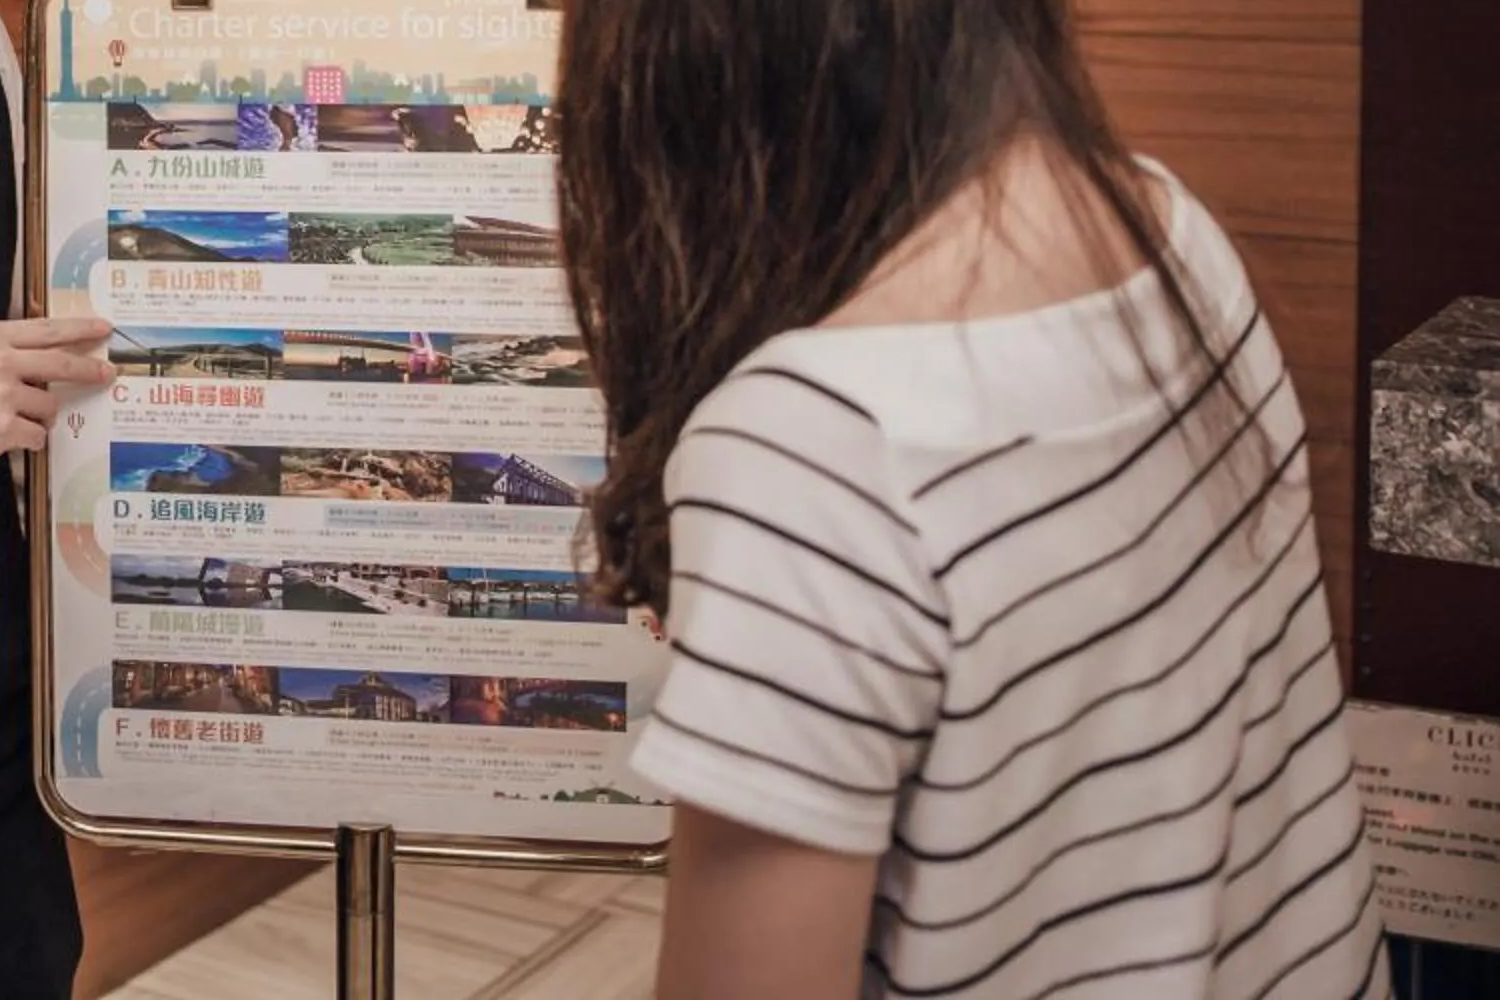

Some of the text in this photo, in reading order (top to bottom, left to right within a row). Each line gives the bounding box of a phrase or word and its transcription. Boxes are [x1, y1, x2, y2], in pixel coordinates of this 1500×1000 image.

[130, 7, 255, 40] Charter
[269, 9, 391, 40] service
[402, 6, 446, 40] for
